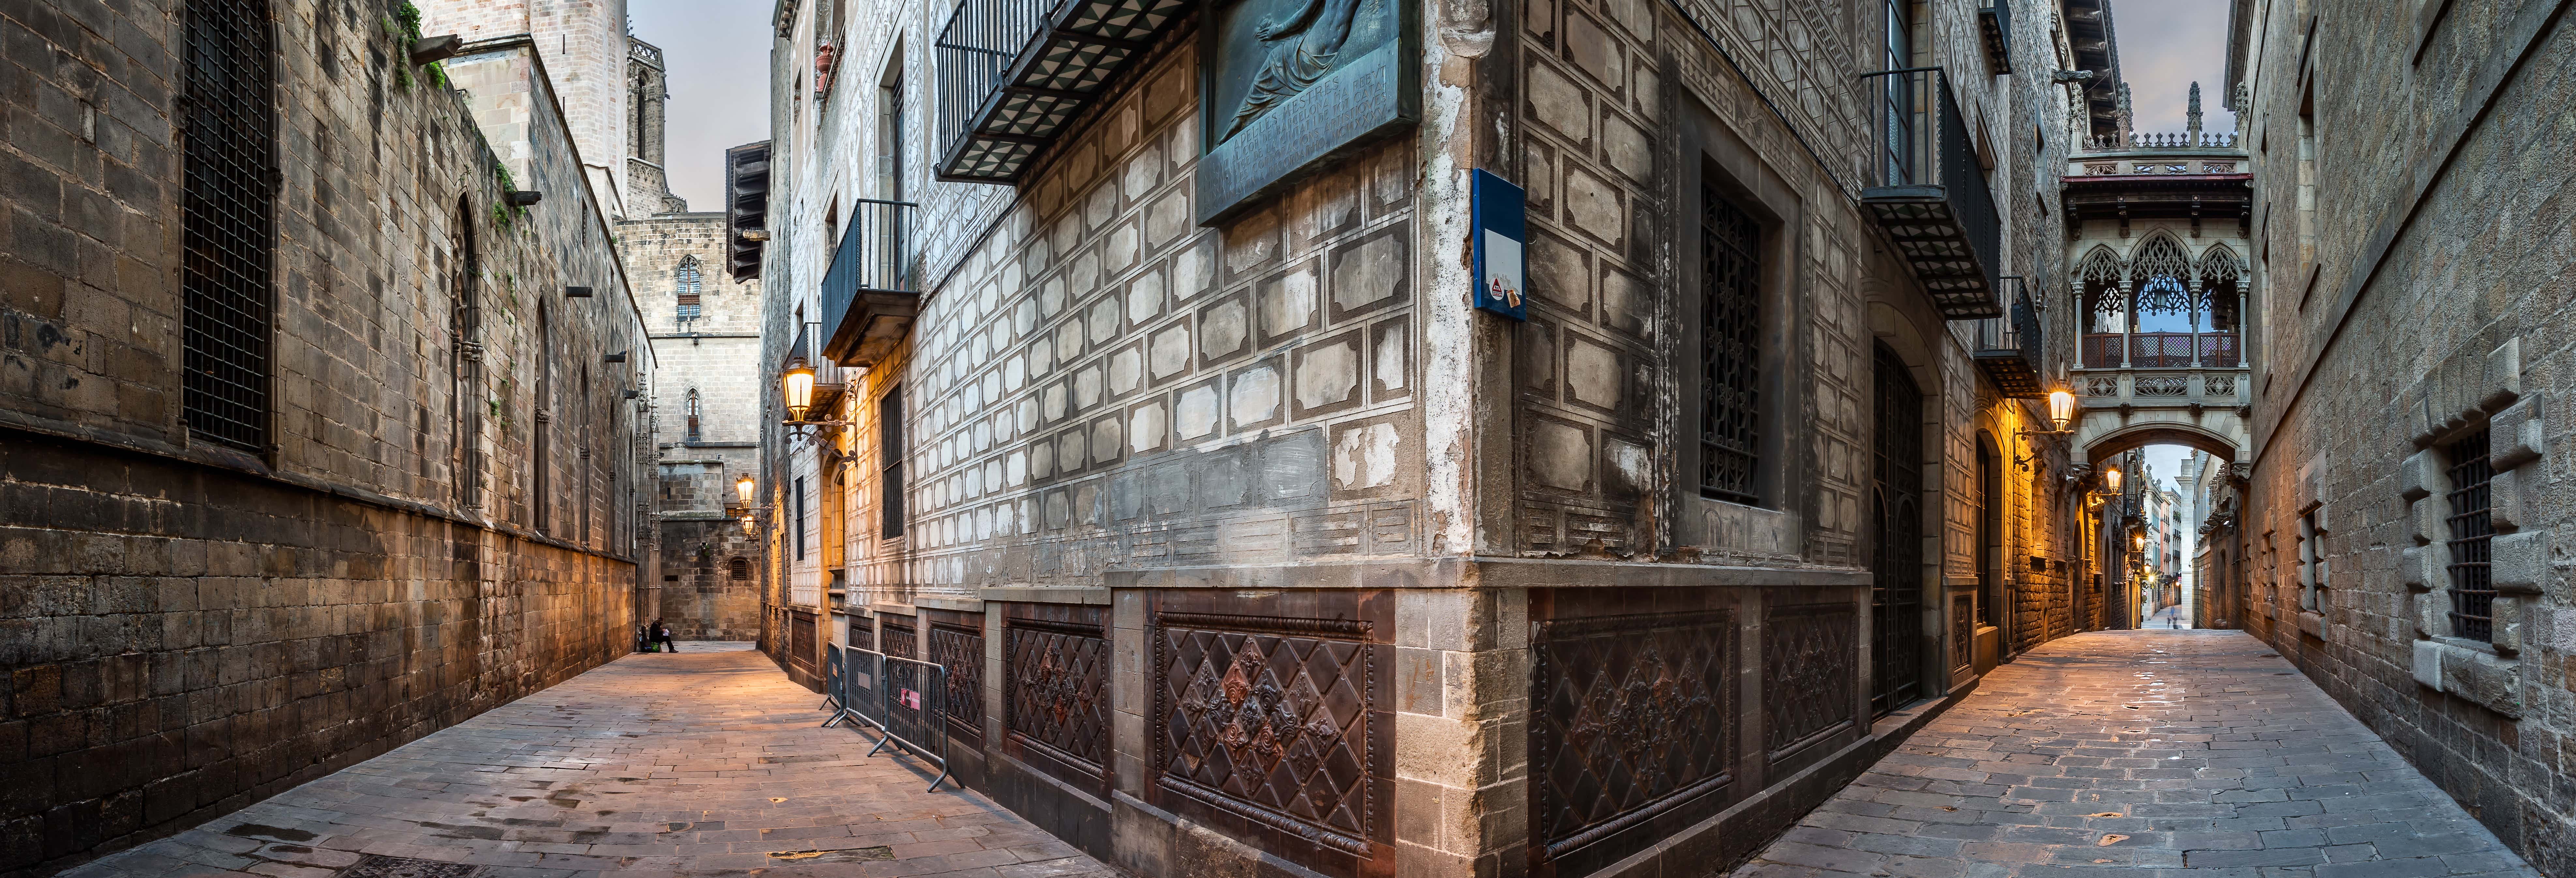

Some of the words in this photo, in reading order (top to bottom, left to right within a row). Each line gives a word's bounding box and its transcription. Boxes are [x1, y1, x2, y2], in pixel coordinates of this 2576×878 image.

[1233, 150, 1240, 162] AL
[1263, 129, 1273, 143] DE
[1276, 95, 1330, 136] BARCELONA
[1334, 85, 1349, 103] HA
[1282, 75, 1339, 120] MESTRES
[1254, 147, 1263, 161] DE
[1266, 138, 1277, 154] LA
[1318, 108, 1329, 124] DE
[1333, 97, 1349, 116] TOT
[1259, 170, 1265, 182] A
